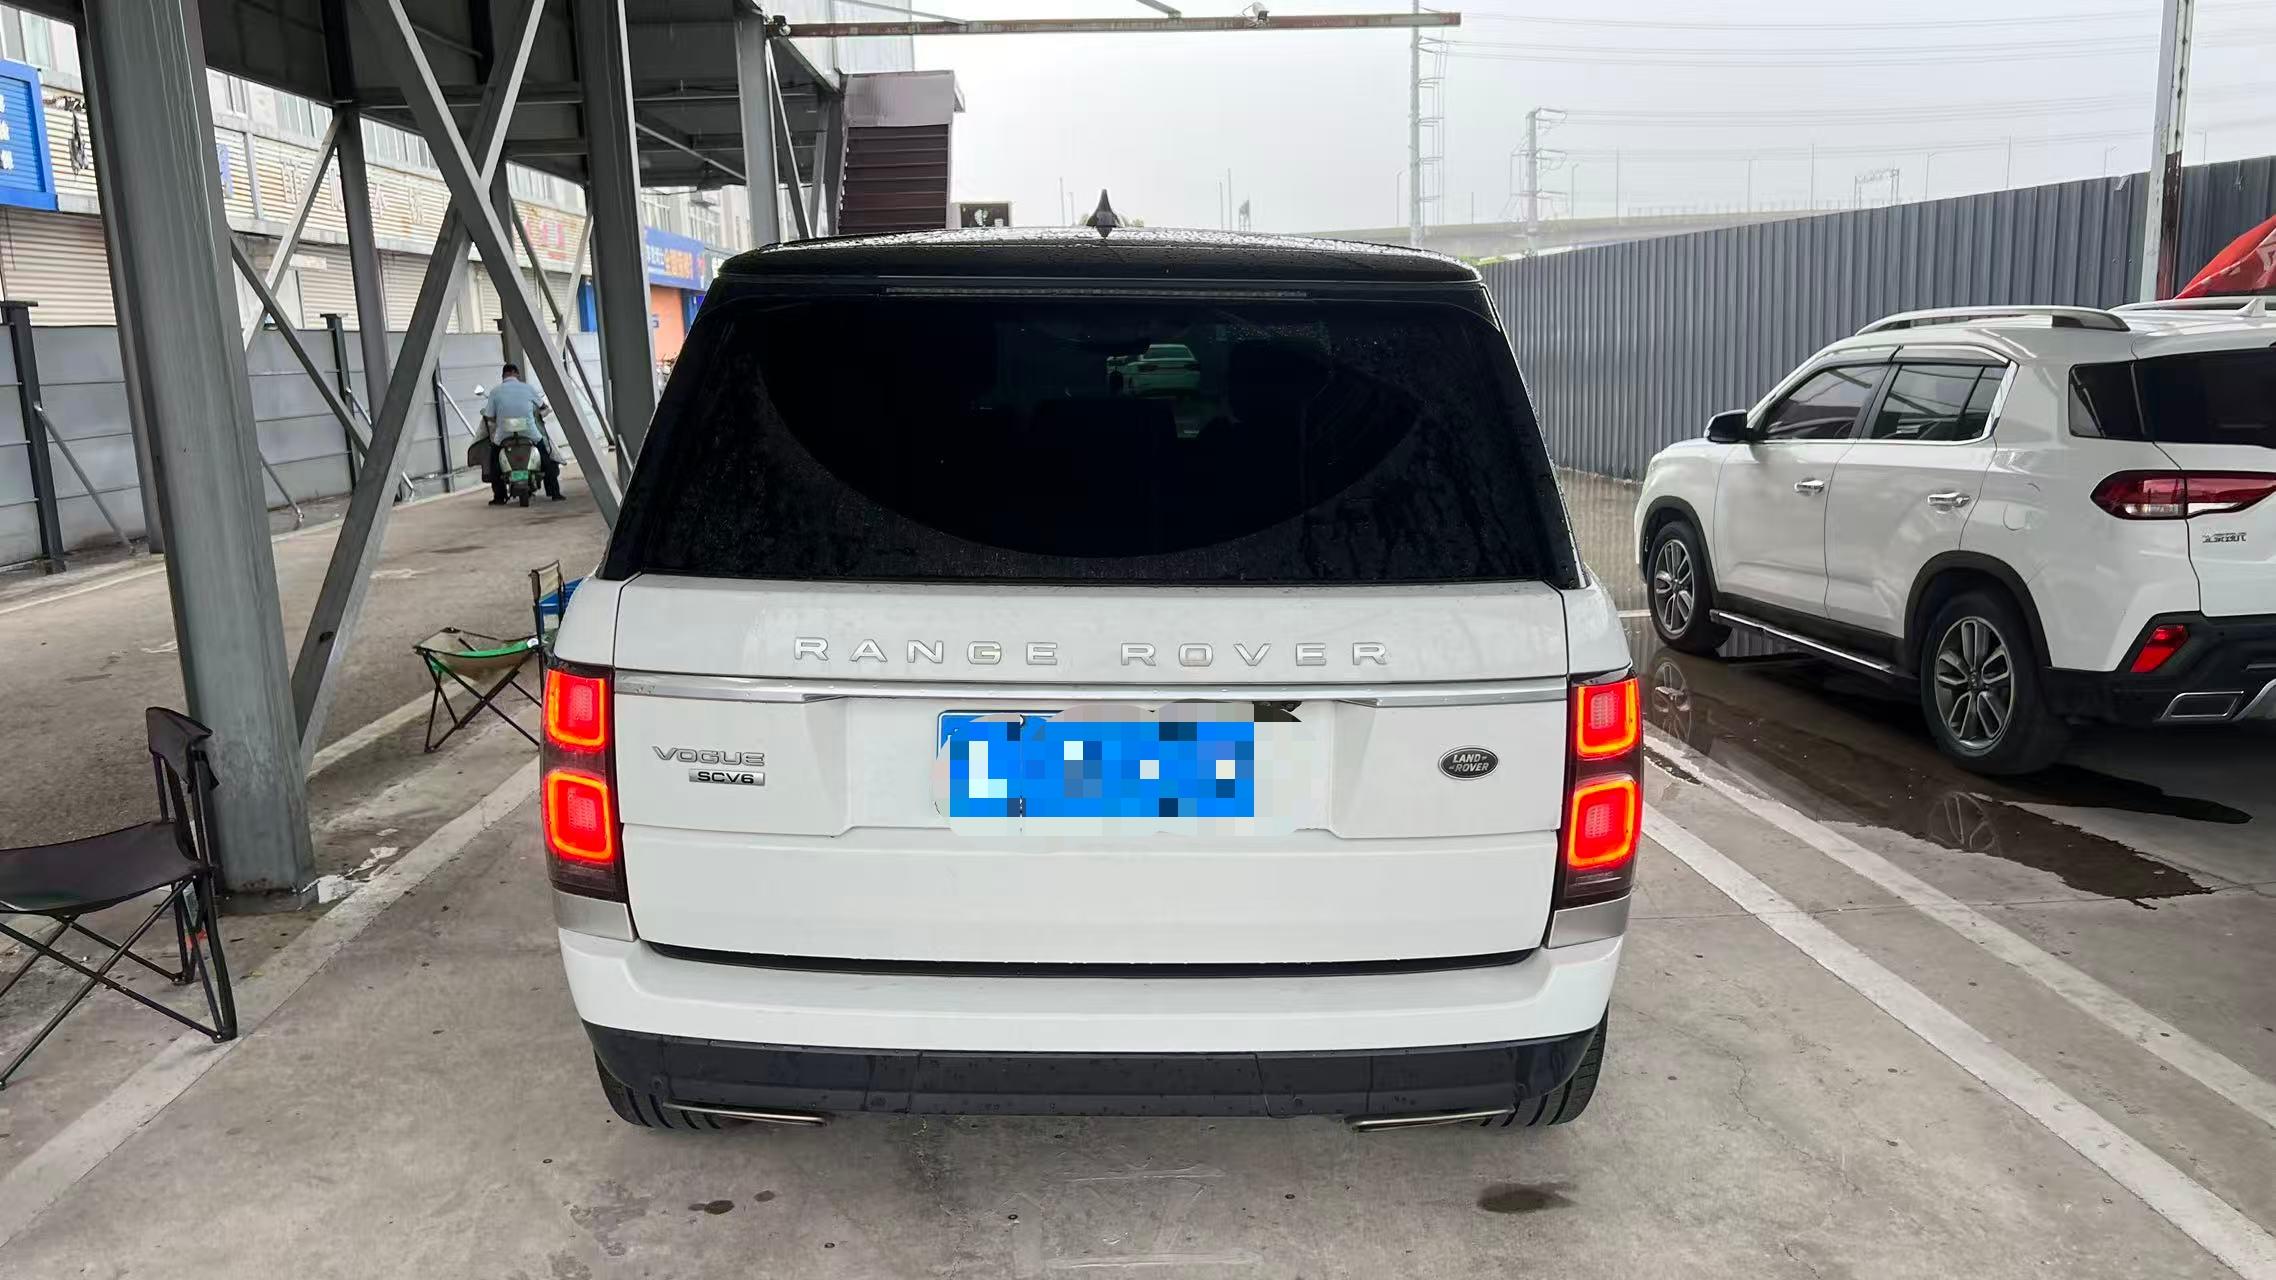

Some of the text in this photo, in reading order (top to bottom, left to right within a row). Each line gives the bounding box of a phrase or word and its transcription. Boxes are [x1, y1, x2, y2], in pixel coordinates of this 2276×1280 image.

[793, 636, 1387, 667] RANGE ROVER
[652, 745, 765, 767] VOGUE
[697, 771, 755, 785] SCV6
